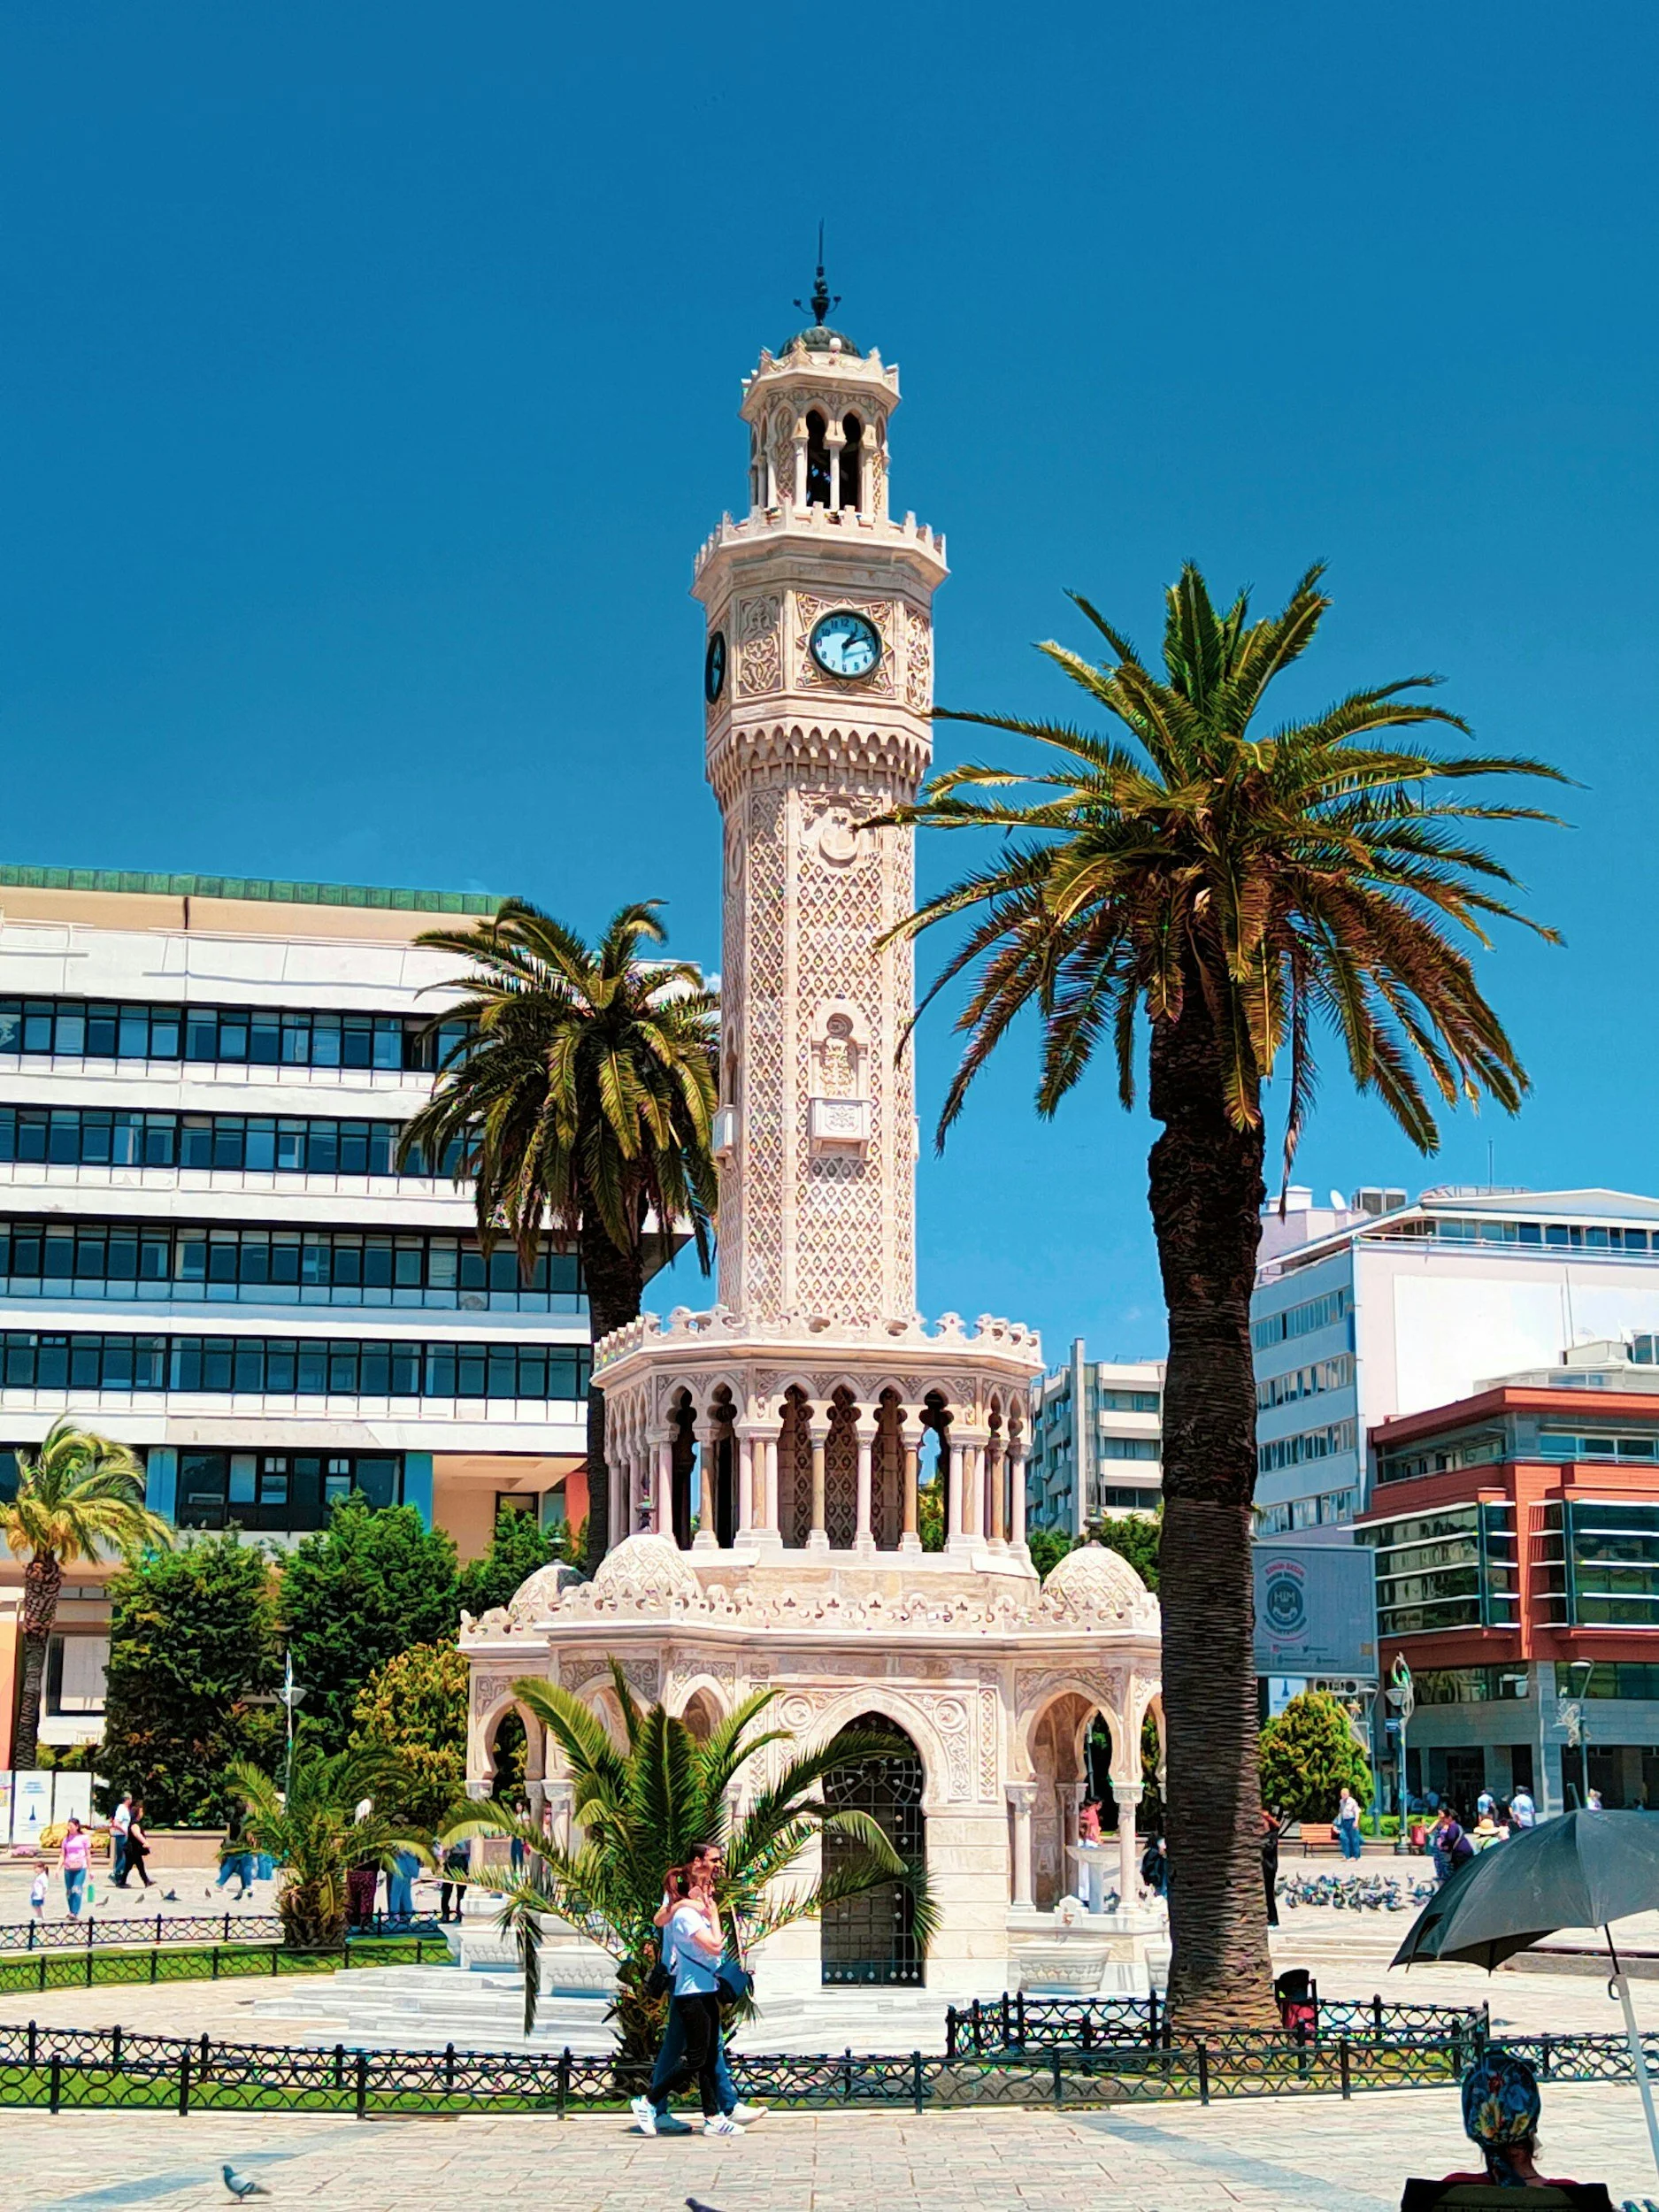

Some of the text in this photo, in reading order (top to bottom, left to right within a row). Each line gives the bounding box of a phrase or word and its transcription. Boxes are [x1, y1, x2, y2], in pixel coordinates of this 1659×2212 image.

[831, 621, 838, 629] 11
[822, 651, 827, 659] 8
[863, 655, 868, 664] 4
[831, 660, 836, 668] 7
[854, 662, 860, 671] 5
